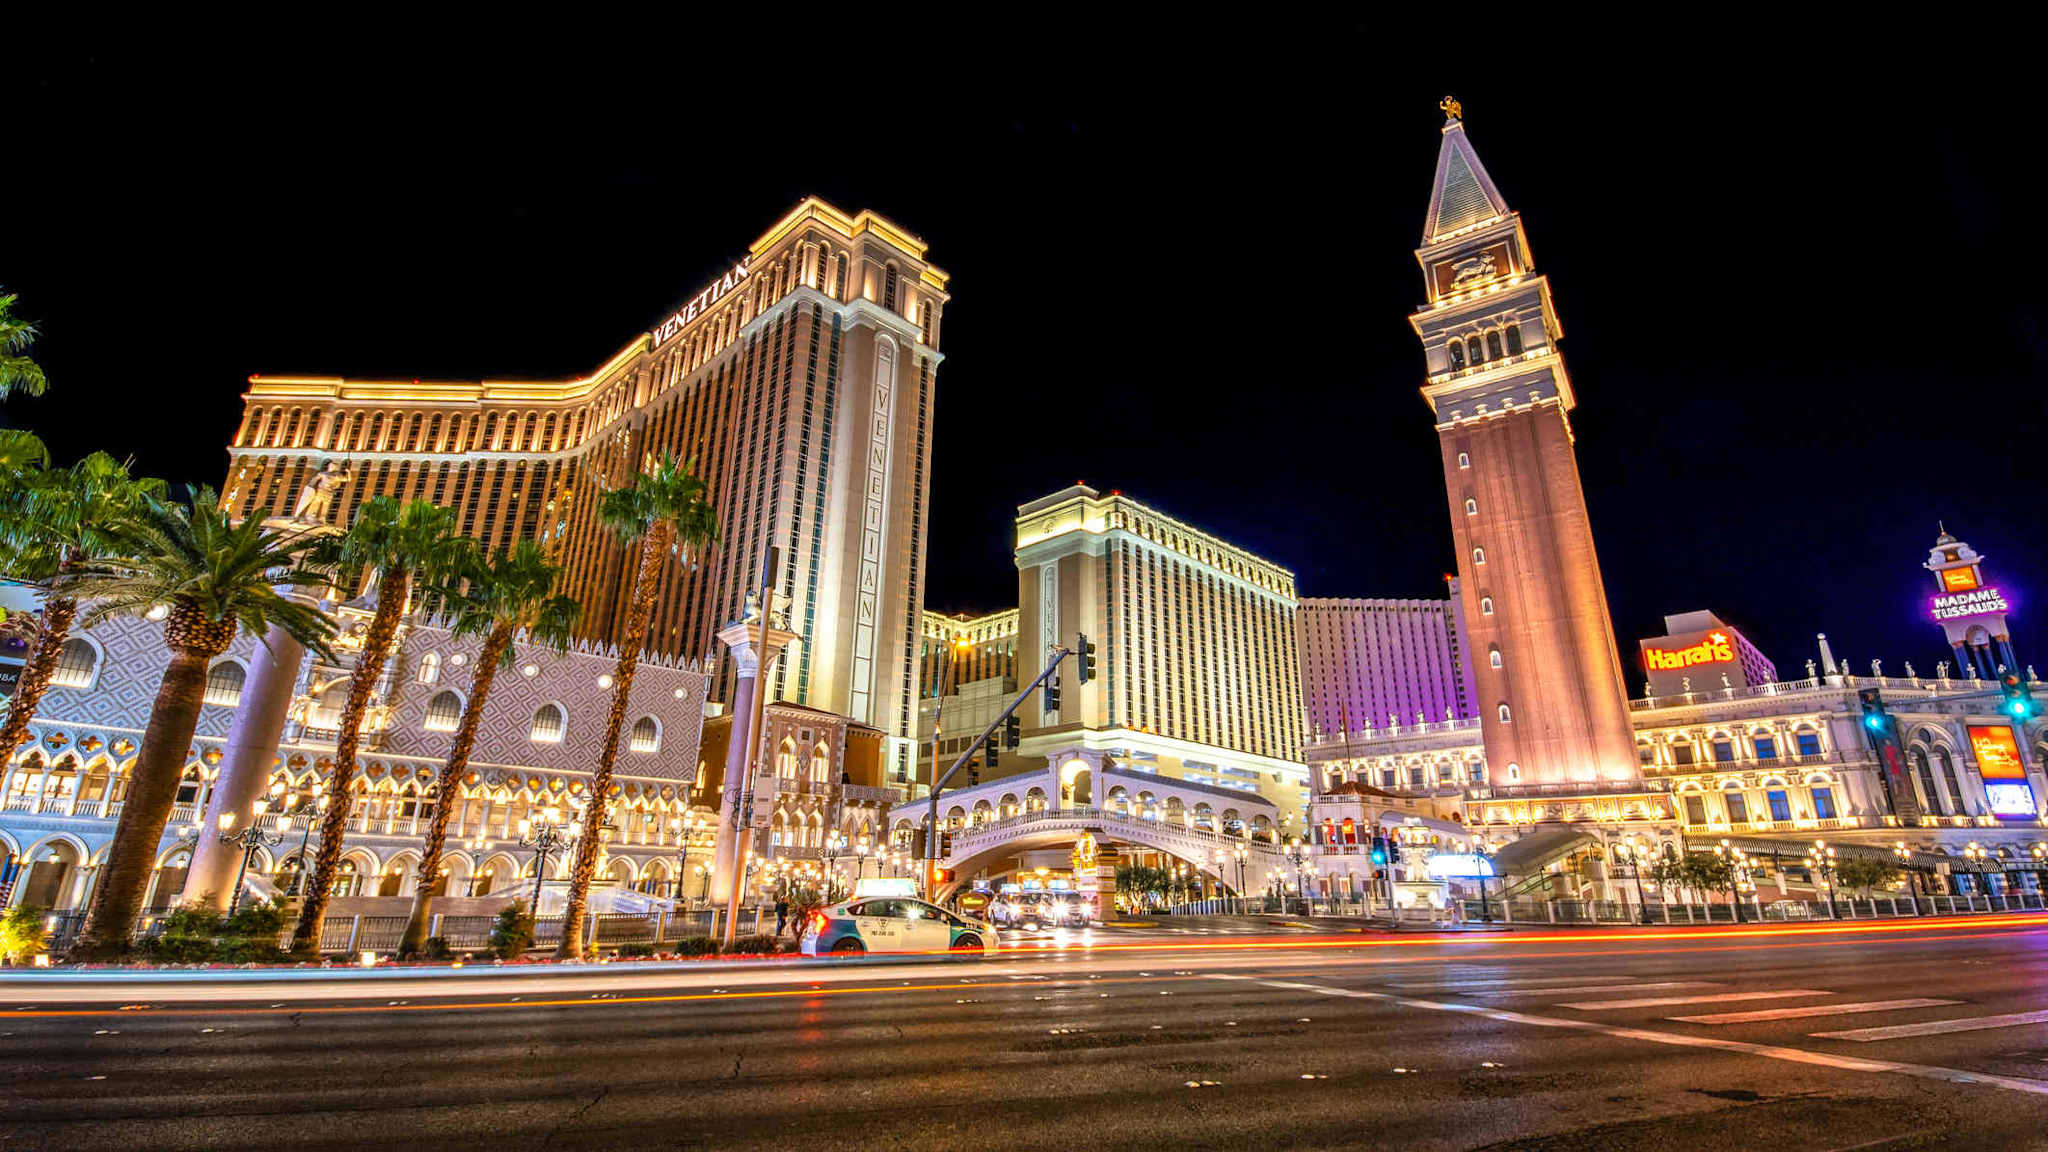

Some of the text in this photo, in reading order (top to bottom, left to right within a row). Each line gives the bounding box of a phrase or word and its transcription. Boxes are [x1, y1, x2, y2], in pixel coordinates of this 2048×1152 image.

[654, 256, 751, 347] VENETIAN
[861, 389, 888, 618] VENETIAN
[1934, 589, 2000, 608] MADAME
